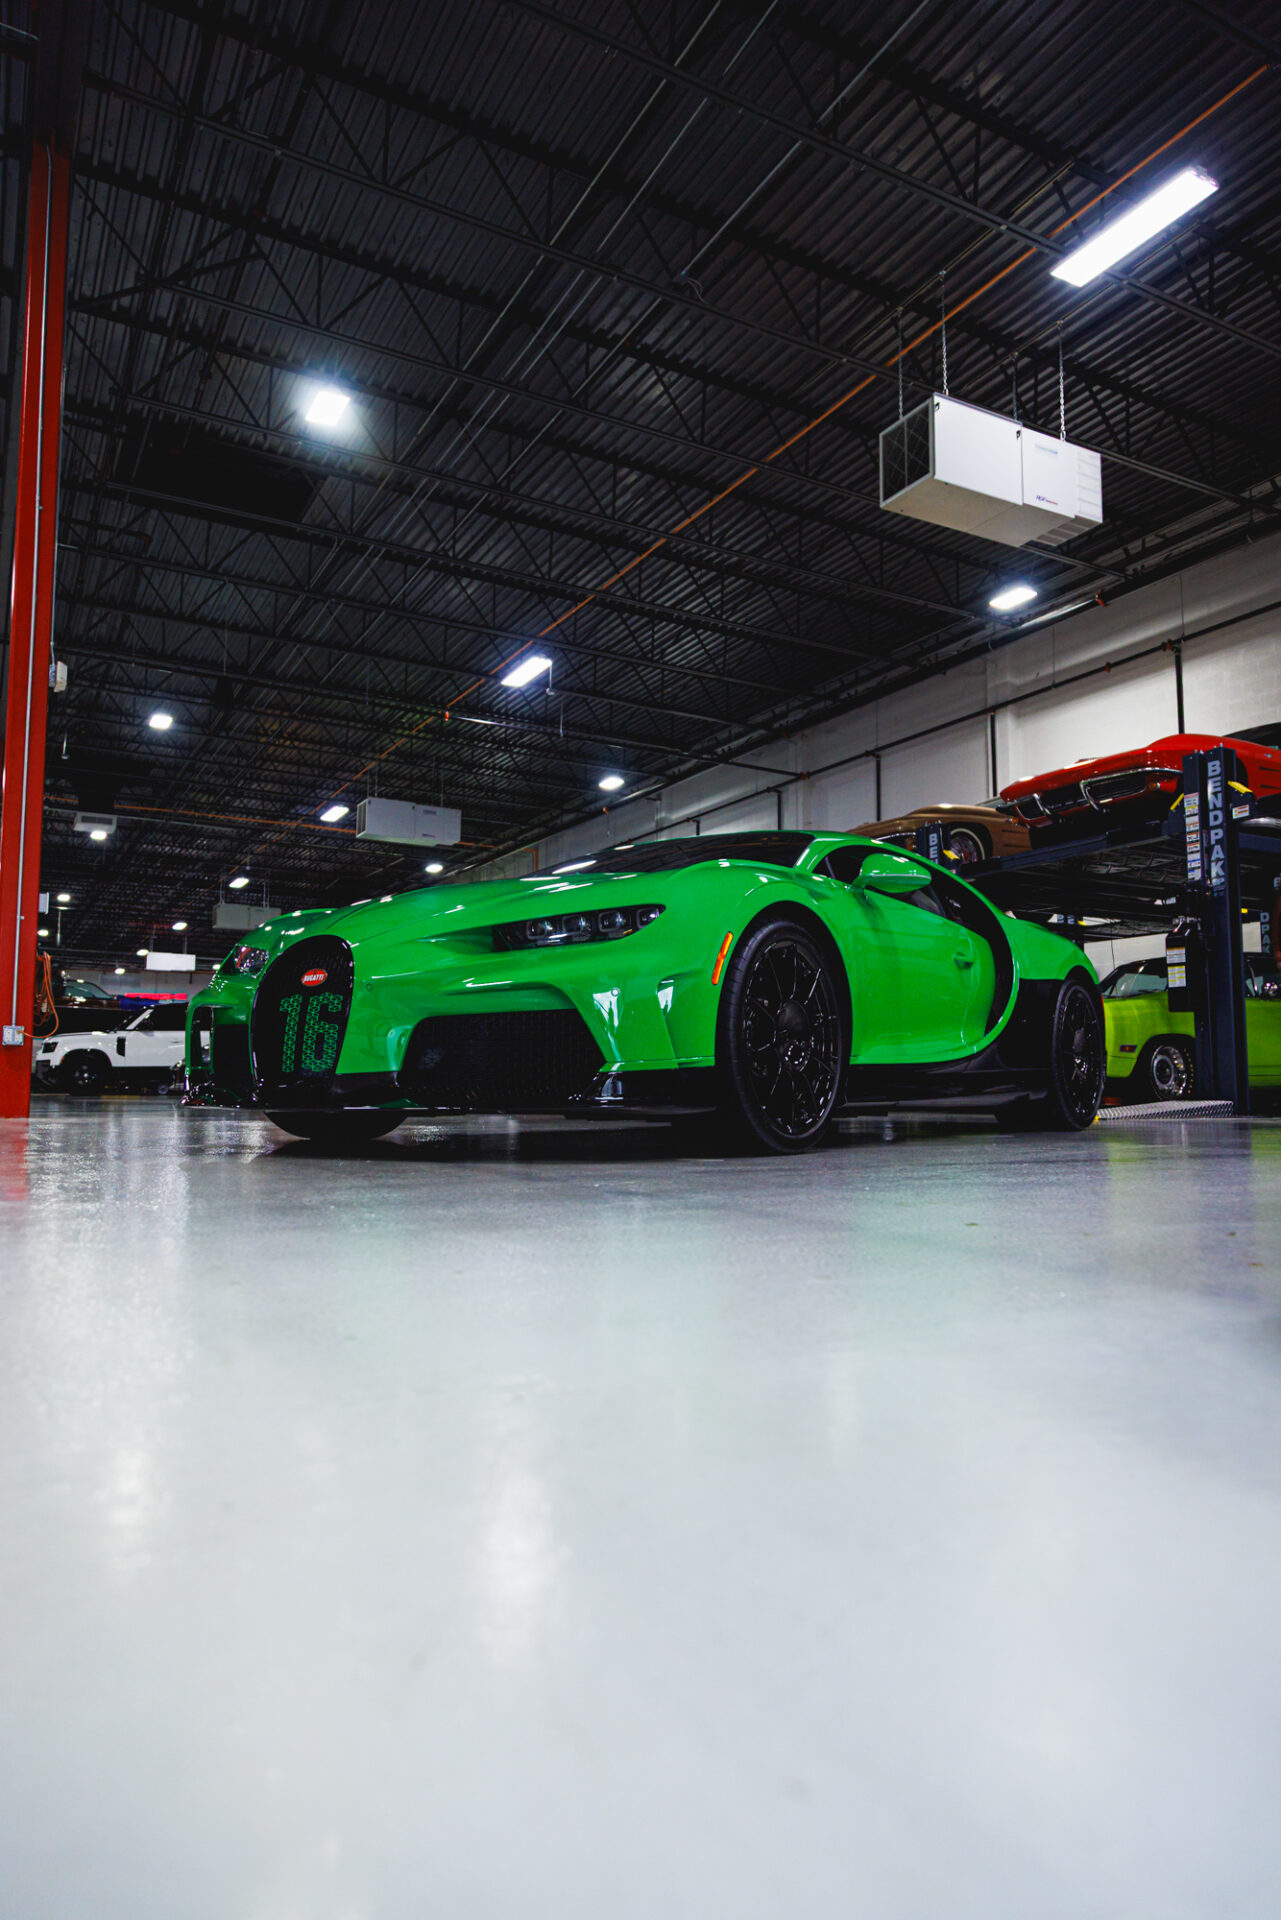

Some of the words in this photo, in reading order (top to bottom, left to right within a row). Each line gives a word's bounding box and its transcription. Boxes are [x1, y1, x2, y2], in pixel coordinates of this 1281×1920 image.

[1207, 759, 1226, 878] BENDPAK
[303, 973, 325, 983] BUGATTI
[279, 991, 344, 1073] 16
